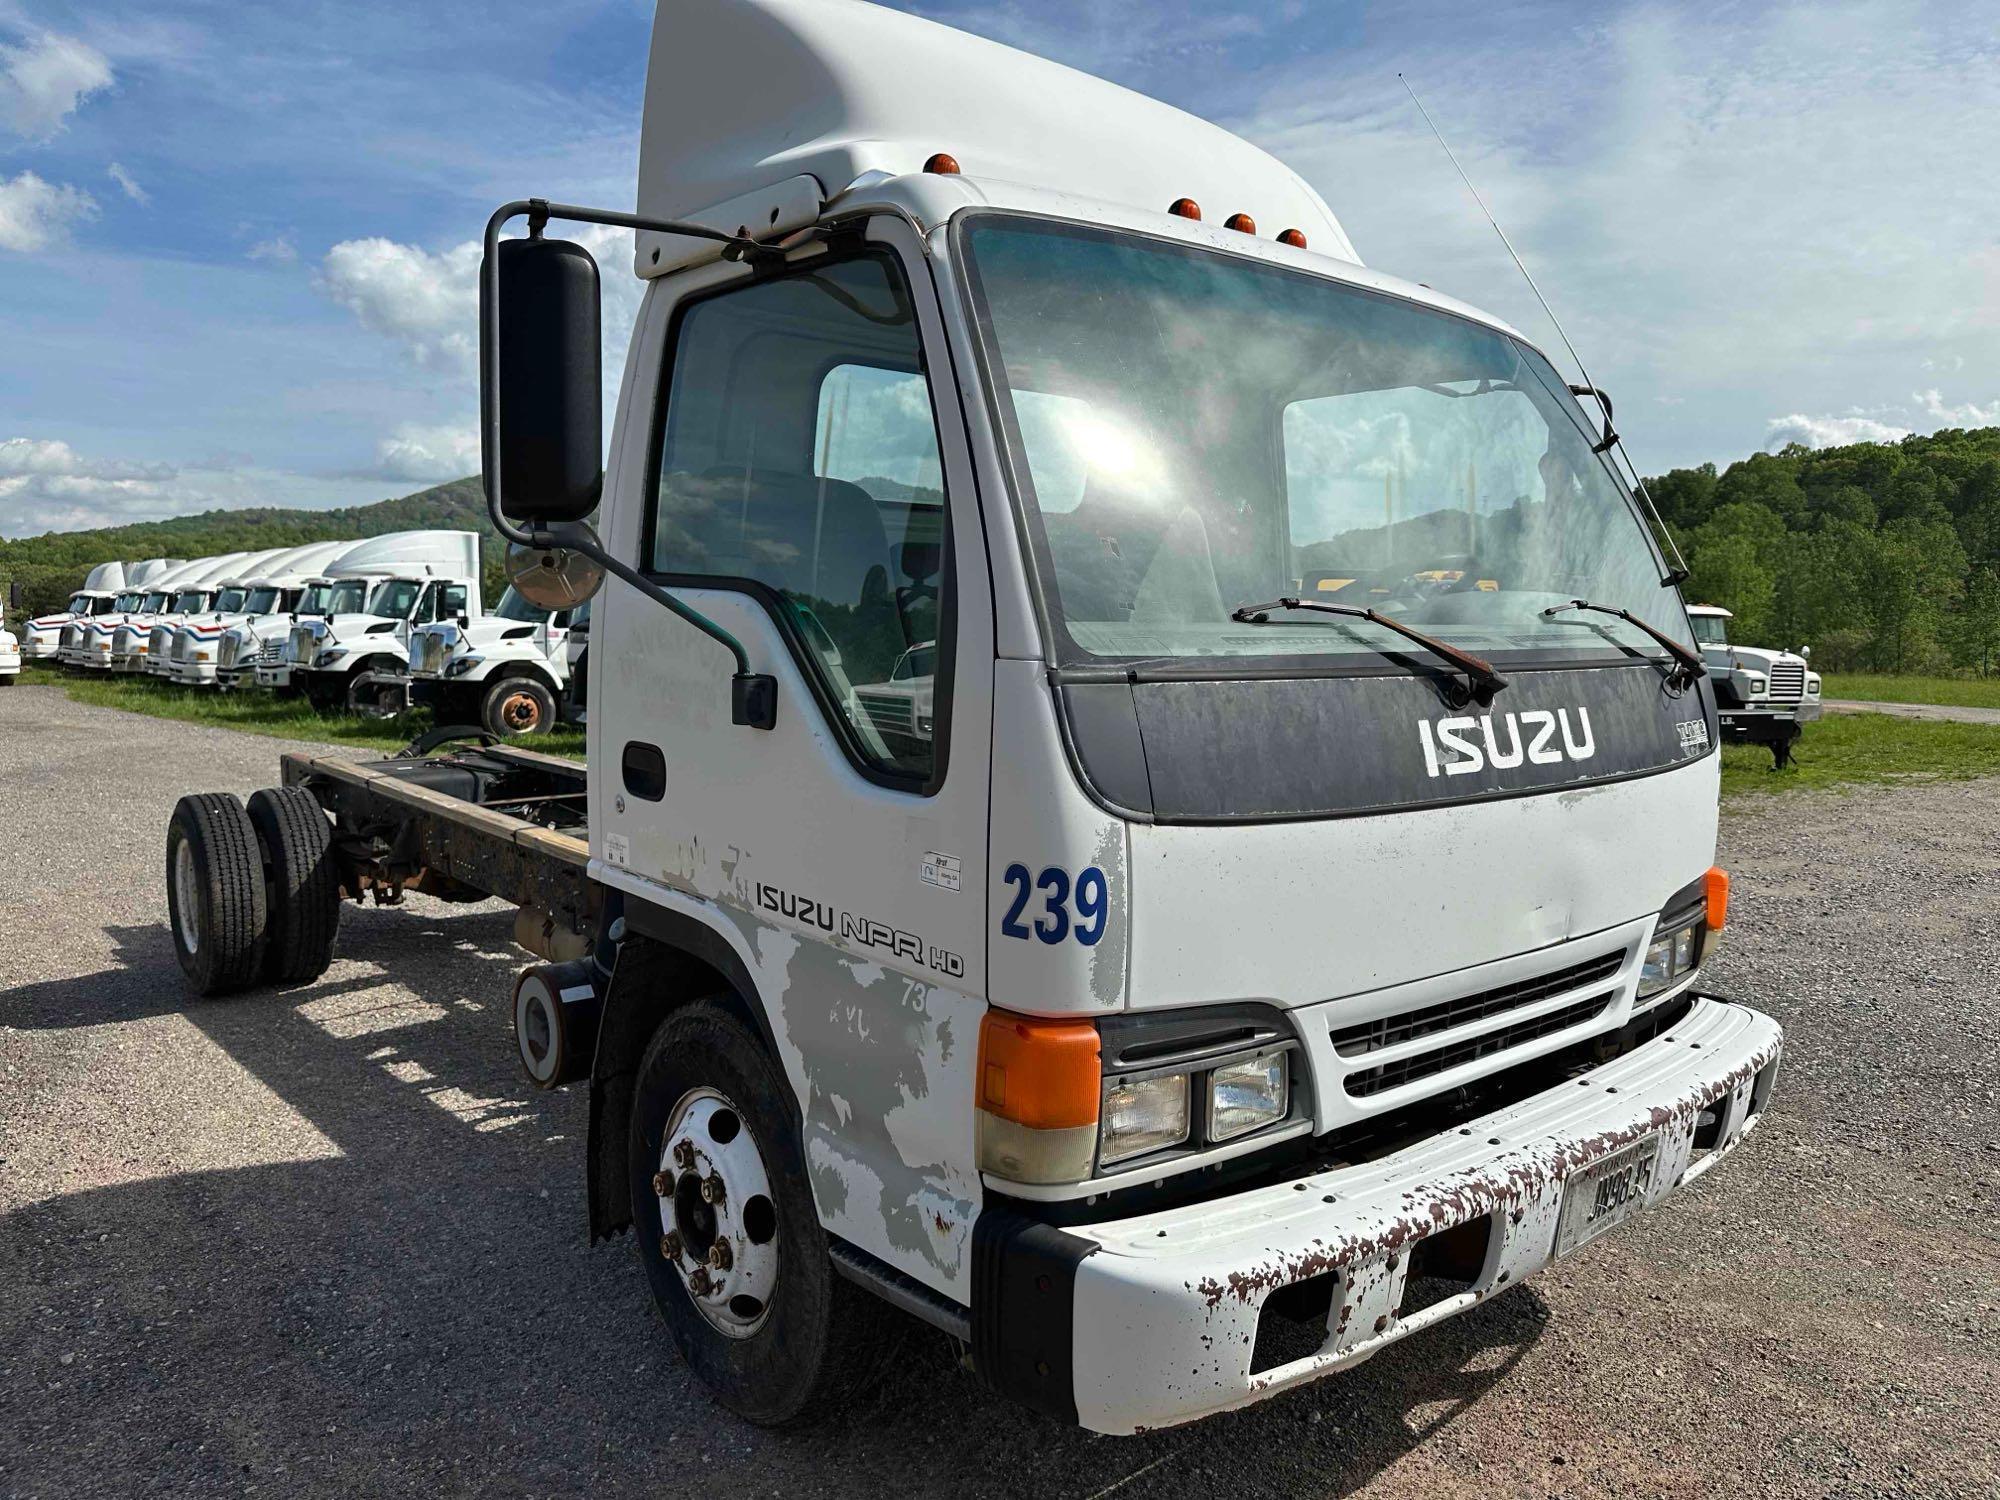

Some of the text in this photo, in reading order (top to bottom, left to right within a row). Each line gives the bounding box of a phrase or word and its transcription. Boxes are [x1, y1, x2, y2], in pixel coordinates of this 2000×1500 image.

[1418, 706, 1595, 777] ISUZU
[756, 882, 964, 978] ISUZU NPR HD
[1001, 863, 1108, 946] 239
